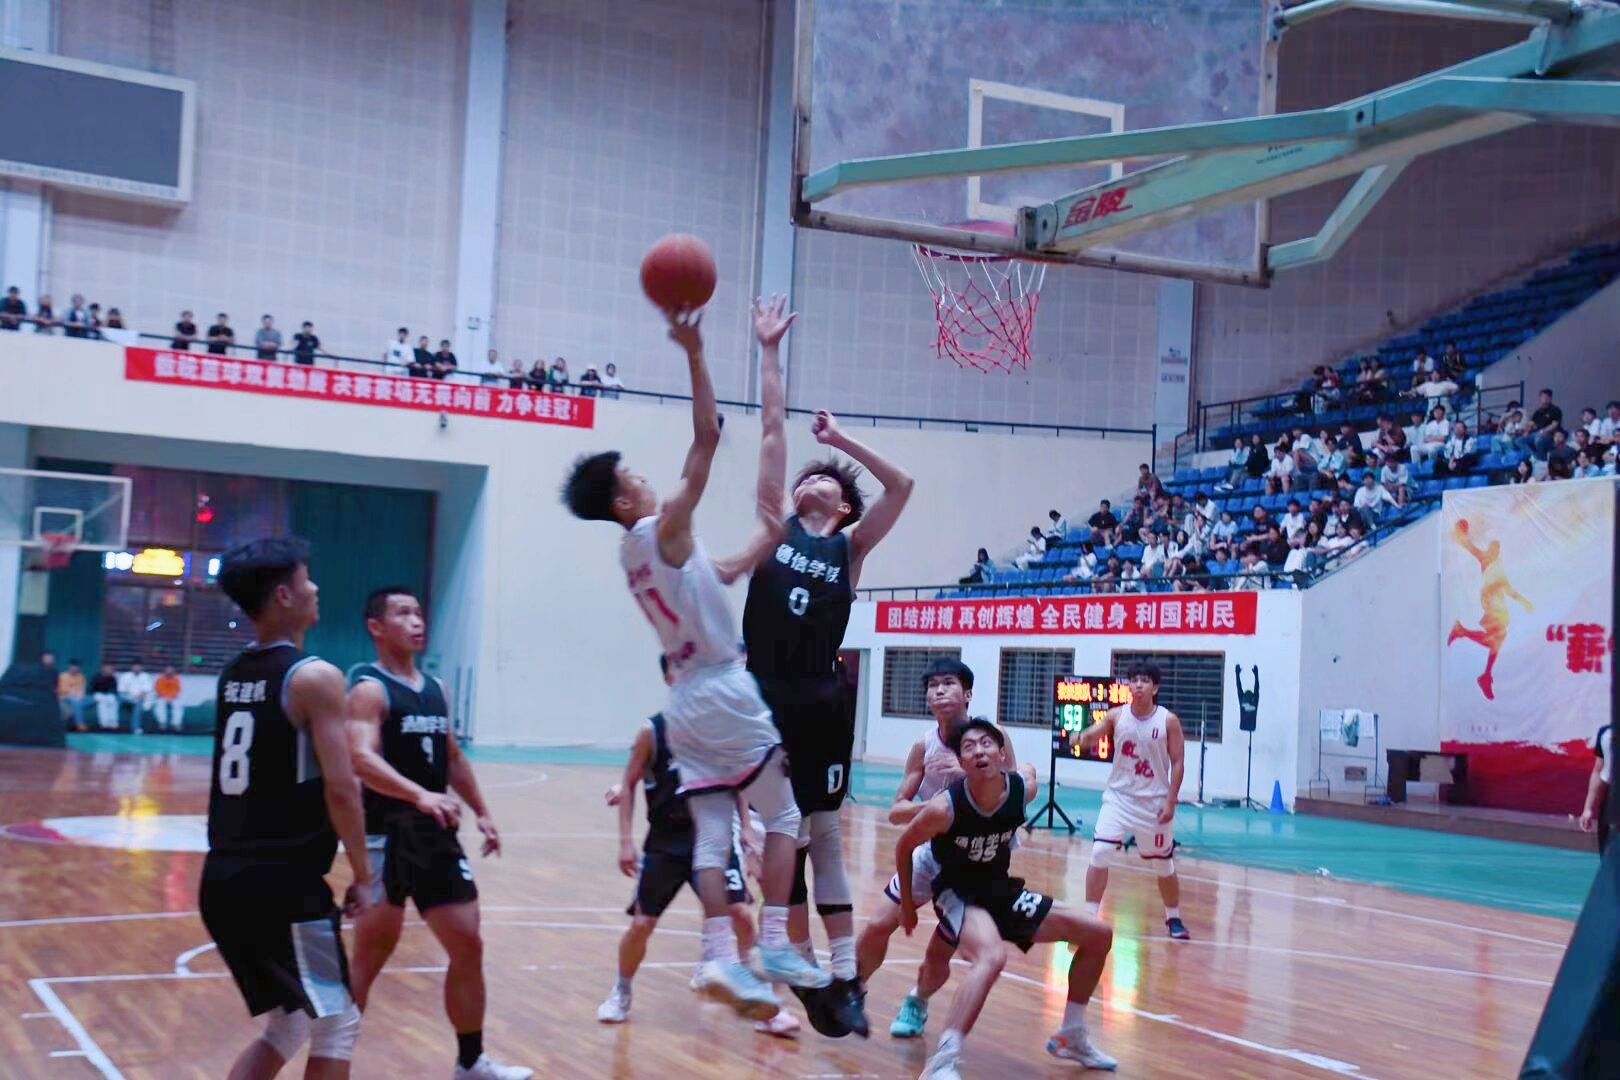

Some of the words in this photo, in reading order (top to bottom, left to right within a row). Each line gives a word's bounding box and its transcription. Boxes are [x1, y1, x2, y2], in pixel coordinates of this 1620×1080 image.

[775, 543, 841, 584] 通信学院
[788, 586, 810, 616] 0
[887, 606, 955, 630] 团结拼搏
[958, 603, 1035, 630] 再创辉煌
[1040, 602, 1128, 630] 全民健身
[1135, 600, 1235, 629] 利国利民
[220, 710, 255, 795] 8
[827, 763, 844, 795] 0
[1154, 833, 1165, 848] 0
